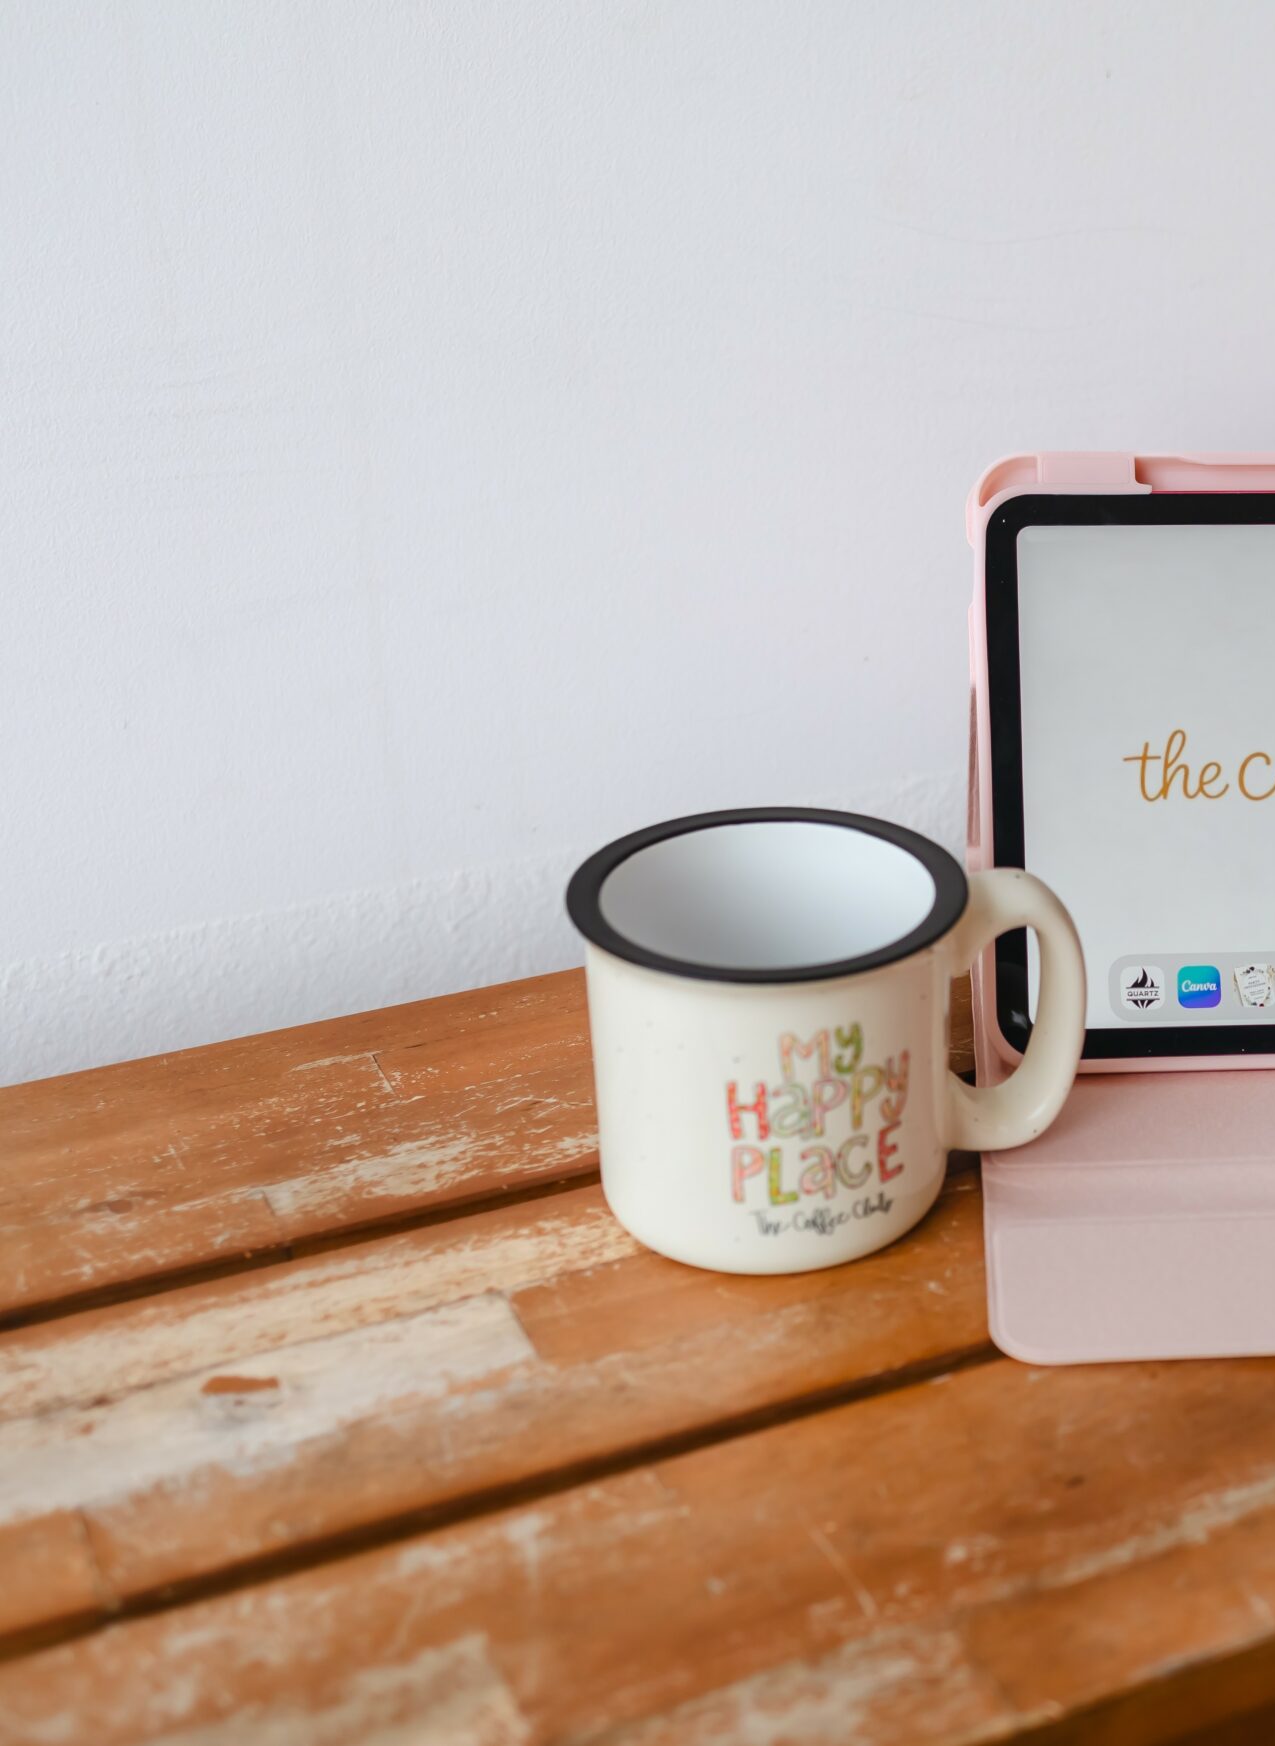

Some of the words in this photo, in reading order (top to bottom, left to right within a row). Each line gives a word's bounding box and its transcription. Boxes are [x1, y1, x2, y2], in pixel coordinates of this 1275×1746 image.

[1123, 729, 1228, 802] the
[1181, 980, 1218, 993] Canva
[749, 1210, 790, 1236] The
[793, 1207, 850, 1235] Coffee
[852, 1192, 894, 1220] Club
